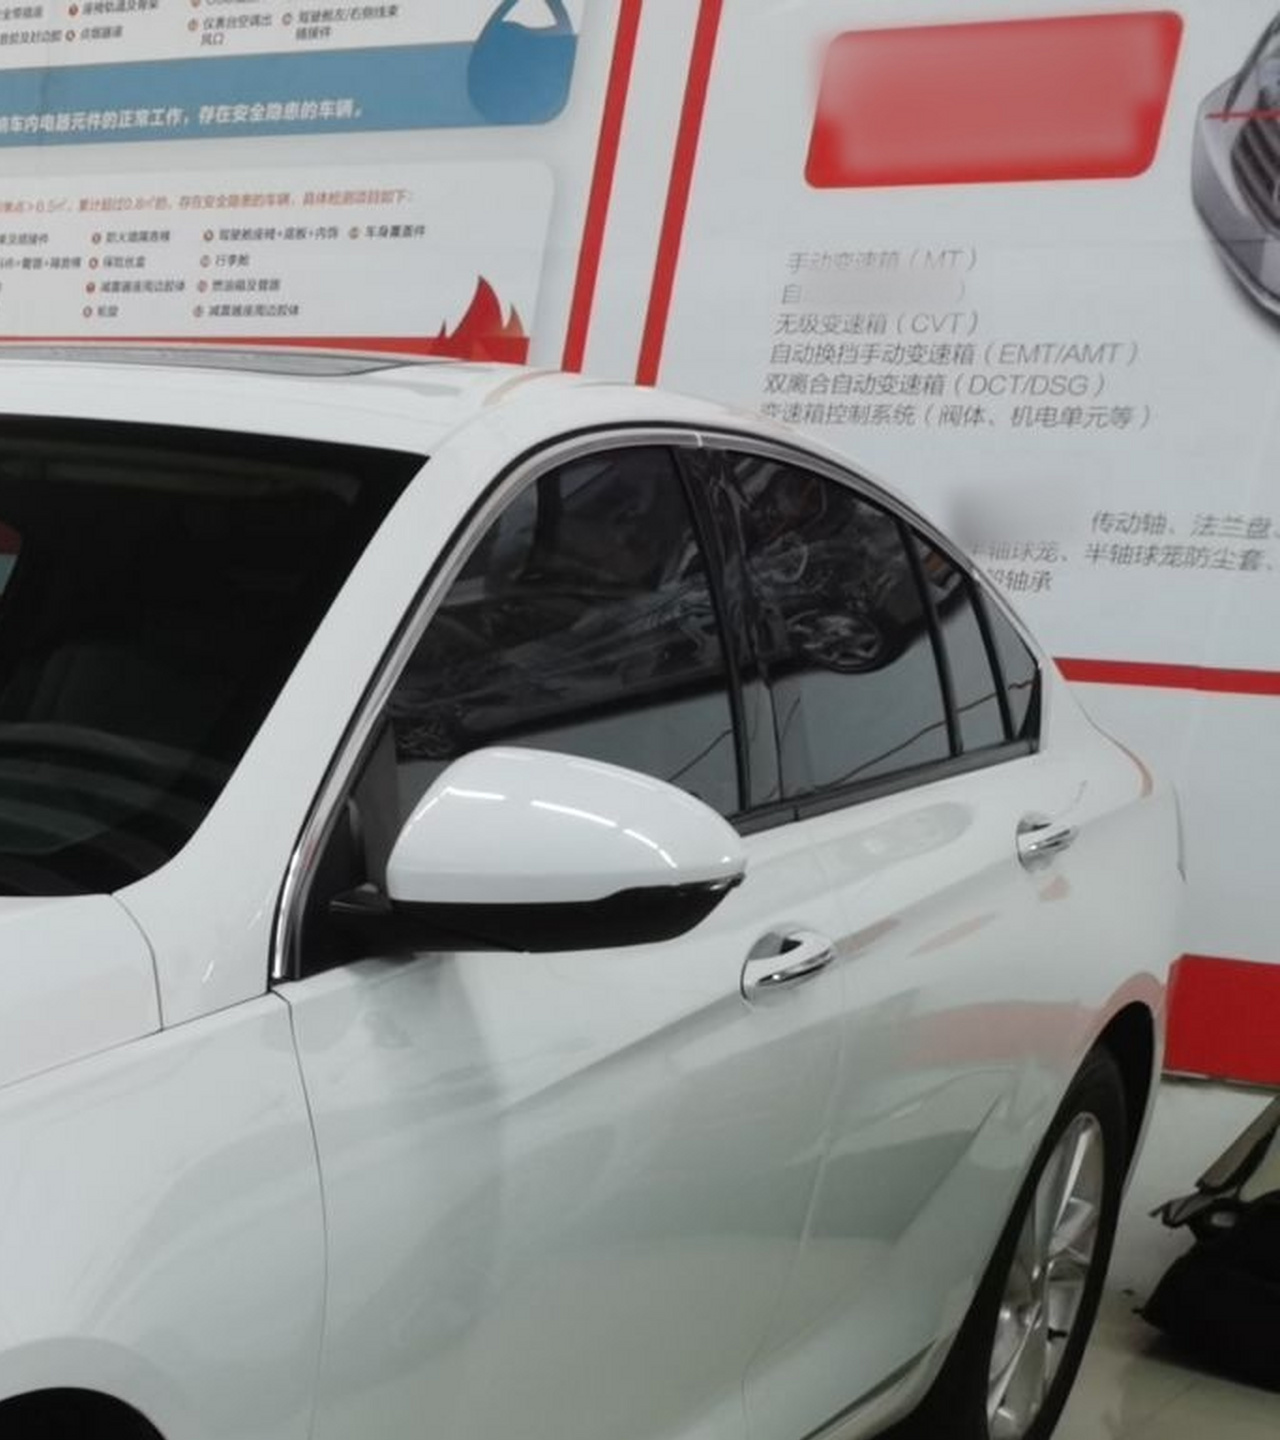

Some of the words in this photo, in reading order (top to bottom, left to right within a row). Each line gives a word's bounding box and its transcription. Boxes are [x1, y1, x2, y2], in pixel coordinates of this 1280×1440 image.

[774, 312, 978, 335] 无级变速箱（CVT）
[764, 372, 1105, 396] 双离合自动变速箱（DCT/DSG）
